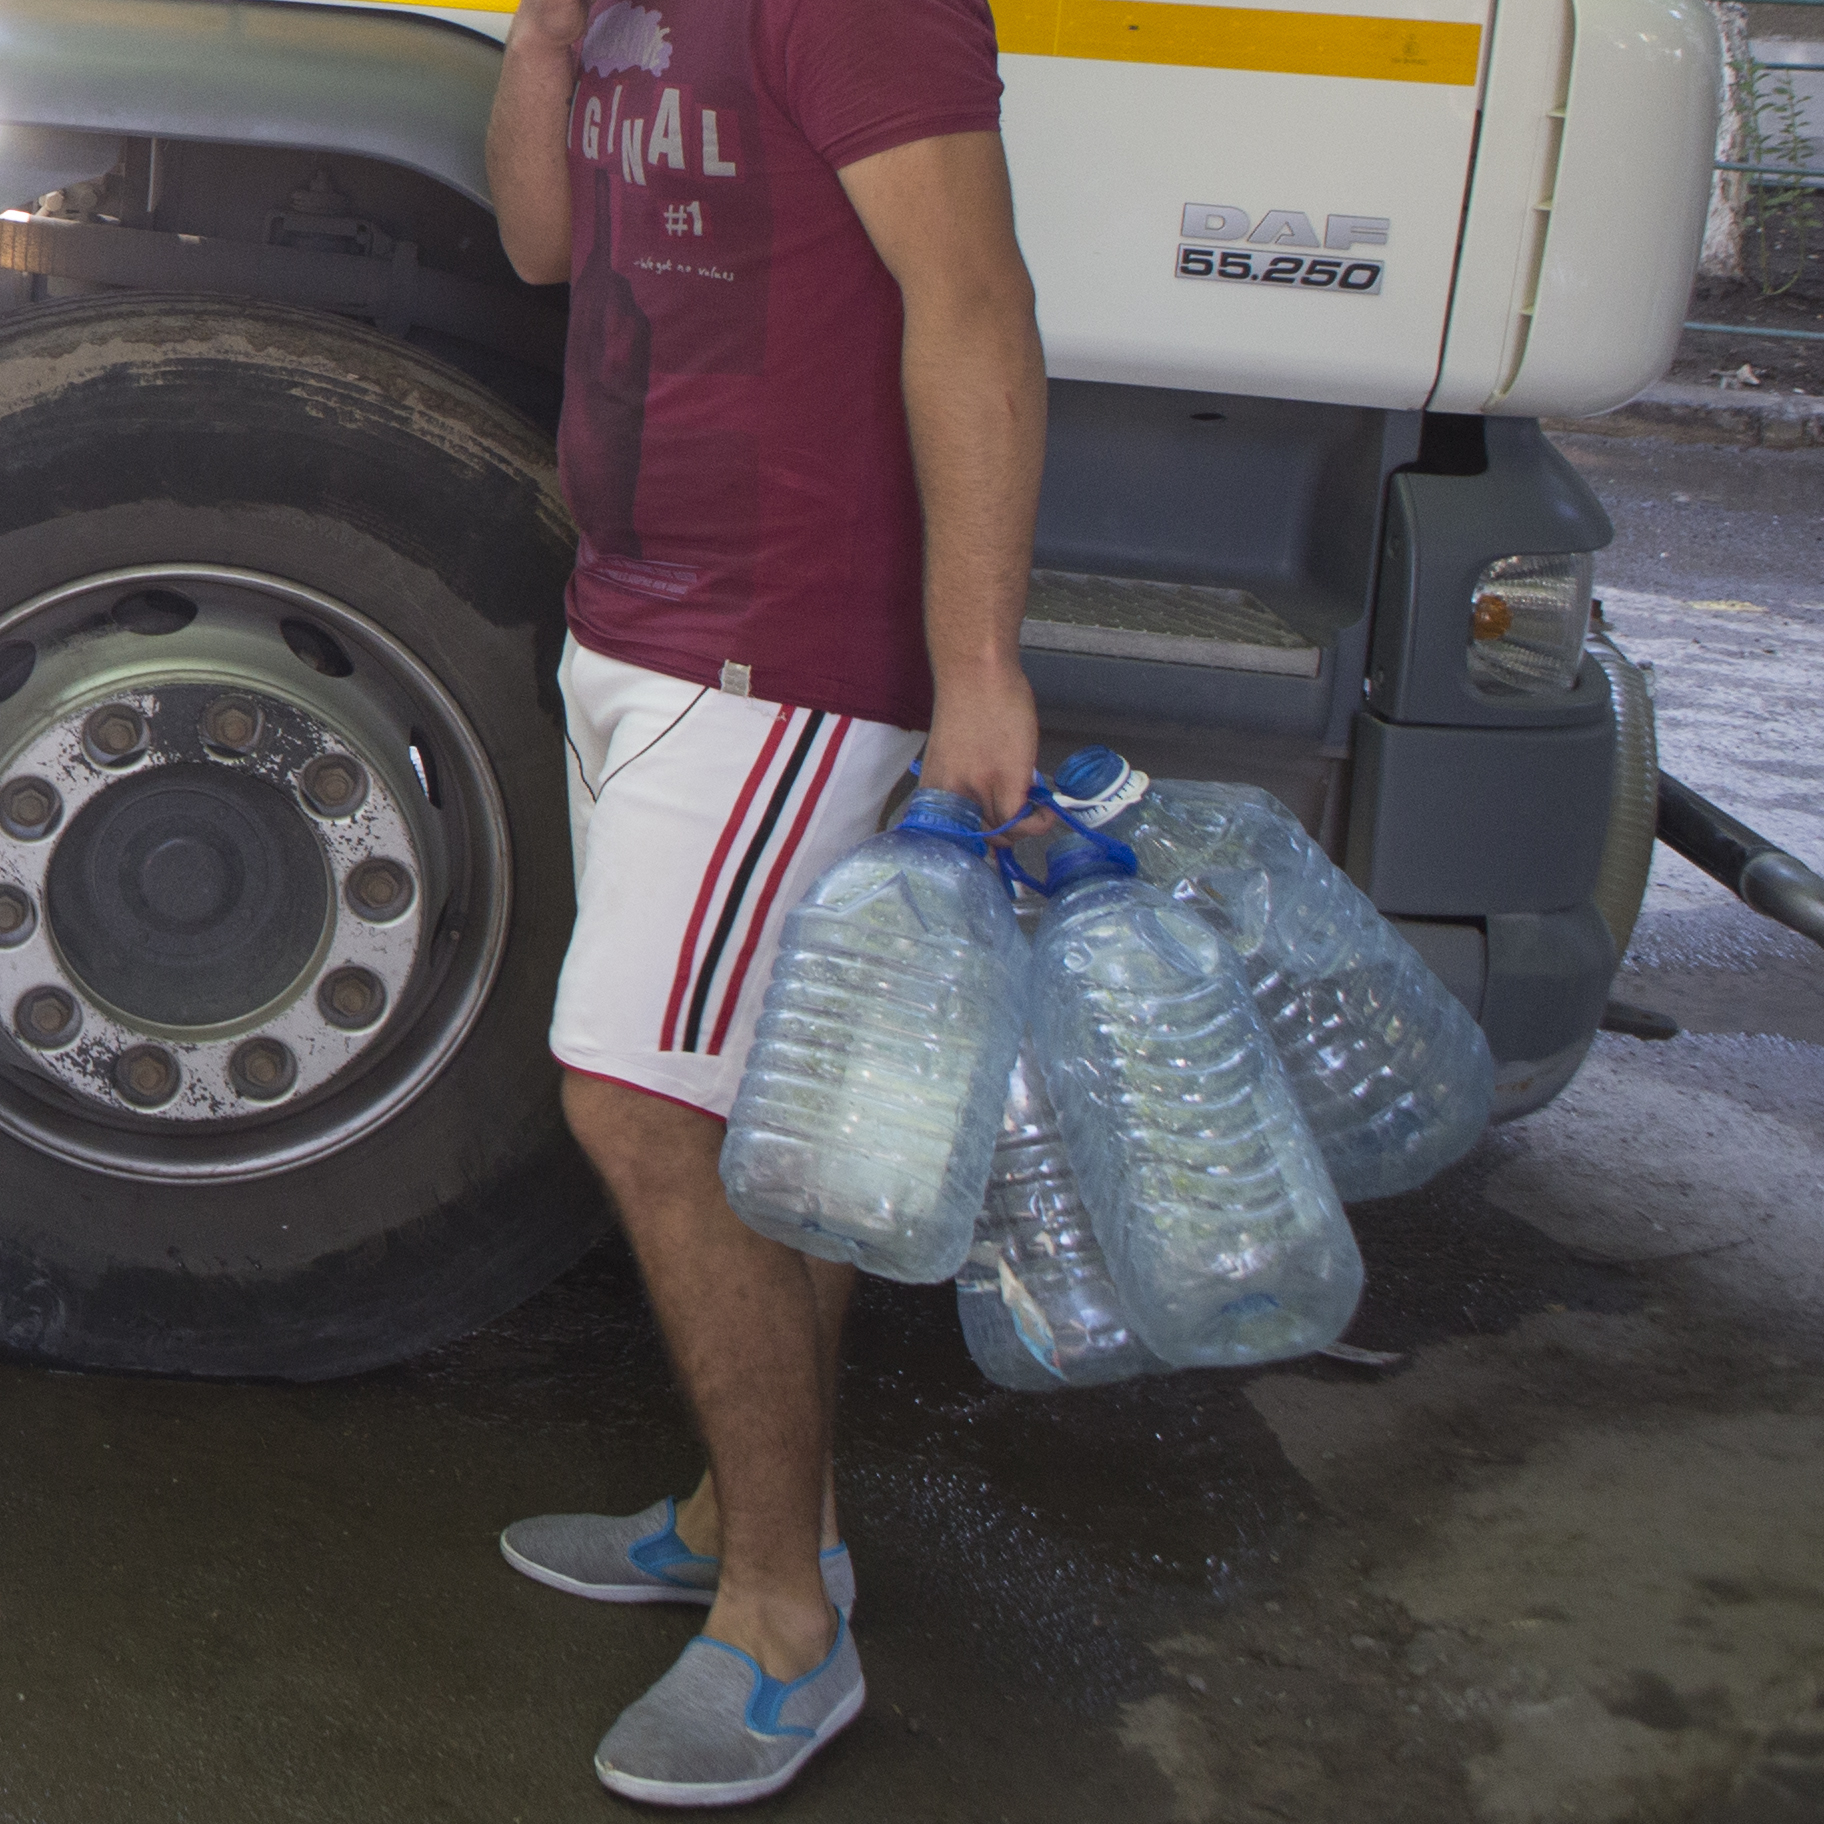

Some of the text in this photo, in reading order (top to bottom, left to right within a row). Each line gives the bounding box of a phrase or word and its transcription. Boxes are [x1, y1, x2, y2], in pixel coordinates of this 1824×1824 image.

[663, 200, 703, 237] #1
[1179, 202, 1391, 251] DAF
[1179, 248, 1382, 291] 55.250
